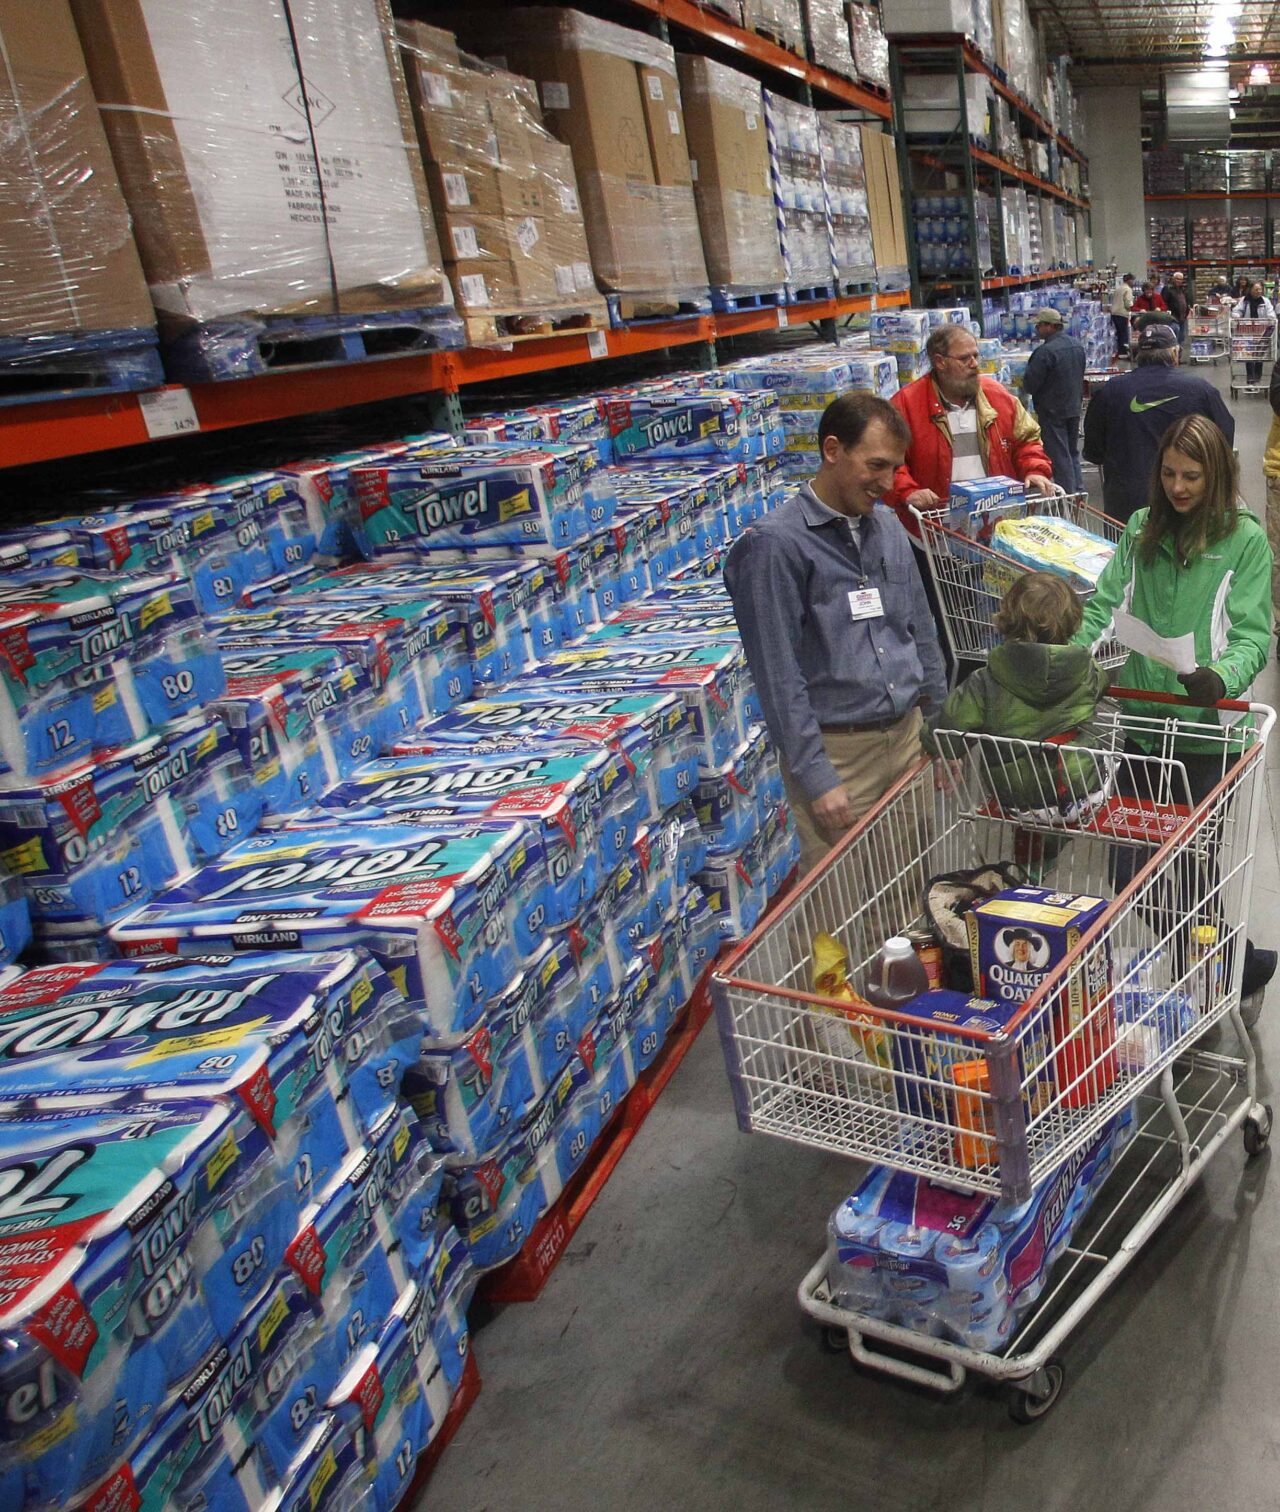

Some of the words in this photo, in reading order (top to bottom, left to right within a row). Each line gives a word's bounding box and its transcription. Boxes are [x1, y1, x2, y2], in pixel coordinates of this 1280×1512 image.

[640, 408, 693, 448] Towel
[404, 480, 488, 536] Towel
[591, 508, 604, 520] 80
[974, 492, 1004, 511] Ziploc
[385, 530, 400, 542] 12
[523, 521, 540, 534] 80
[285, 544, 302, 562] 80
[72, 606, 115, 624] KIRKLAND
[404, 628, 430, 663] Towel
[551, 647, 702, 678] Towel
[162, 670, 194, 700] 80
[448, 679, 461, 696] 80
[466, 699, 621, 734] Towel
[48, 719, 76, 751] 12
[351, 734, 372, 757] 80
[134, 745, 168, 766] KIRKLAND
[136, 748, 190, 802] Towel
[360, 758, 548, 804] Towel
[118, 866, 142, 898] 12
[199, 840, 448, 902] Towel
[35, 888, 64, 905] 80
[237, 910, 317, 922] KIRKLAND
[528, 904, 544, 932] 80
[140, 940, 164, 954] Most
[234, 931, 298, 944] KIRKLAND
[199, 1054, 238, 1070] 80
[120, 1122, 156, 1140] 12
[128, 1182, 172, 1230] KIRKLAND
[946, 1214, 966, 1232] 36
[232, 1235, 266, 1287] 80
[347, 1308, 366, 1347] 12
[184, 1346, 228, 1401] KIRKLAND
[187, 1337, 252, 1443] Towel
[398, 1440, 413, 1478] 12
